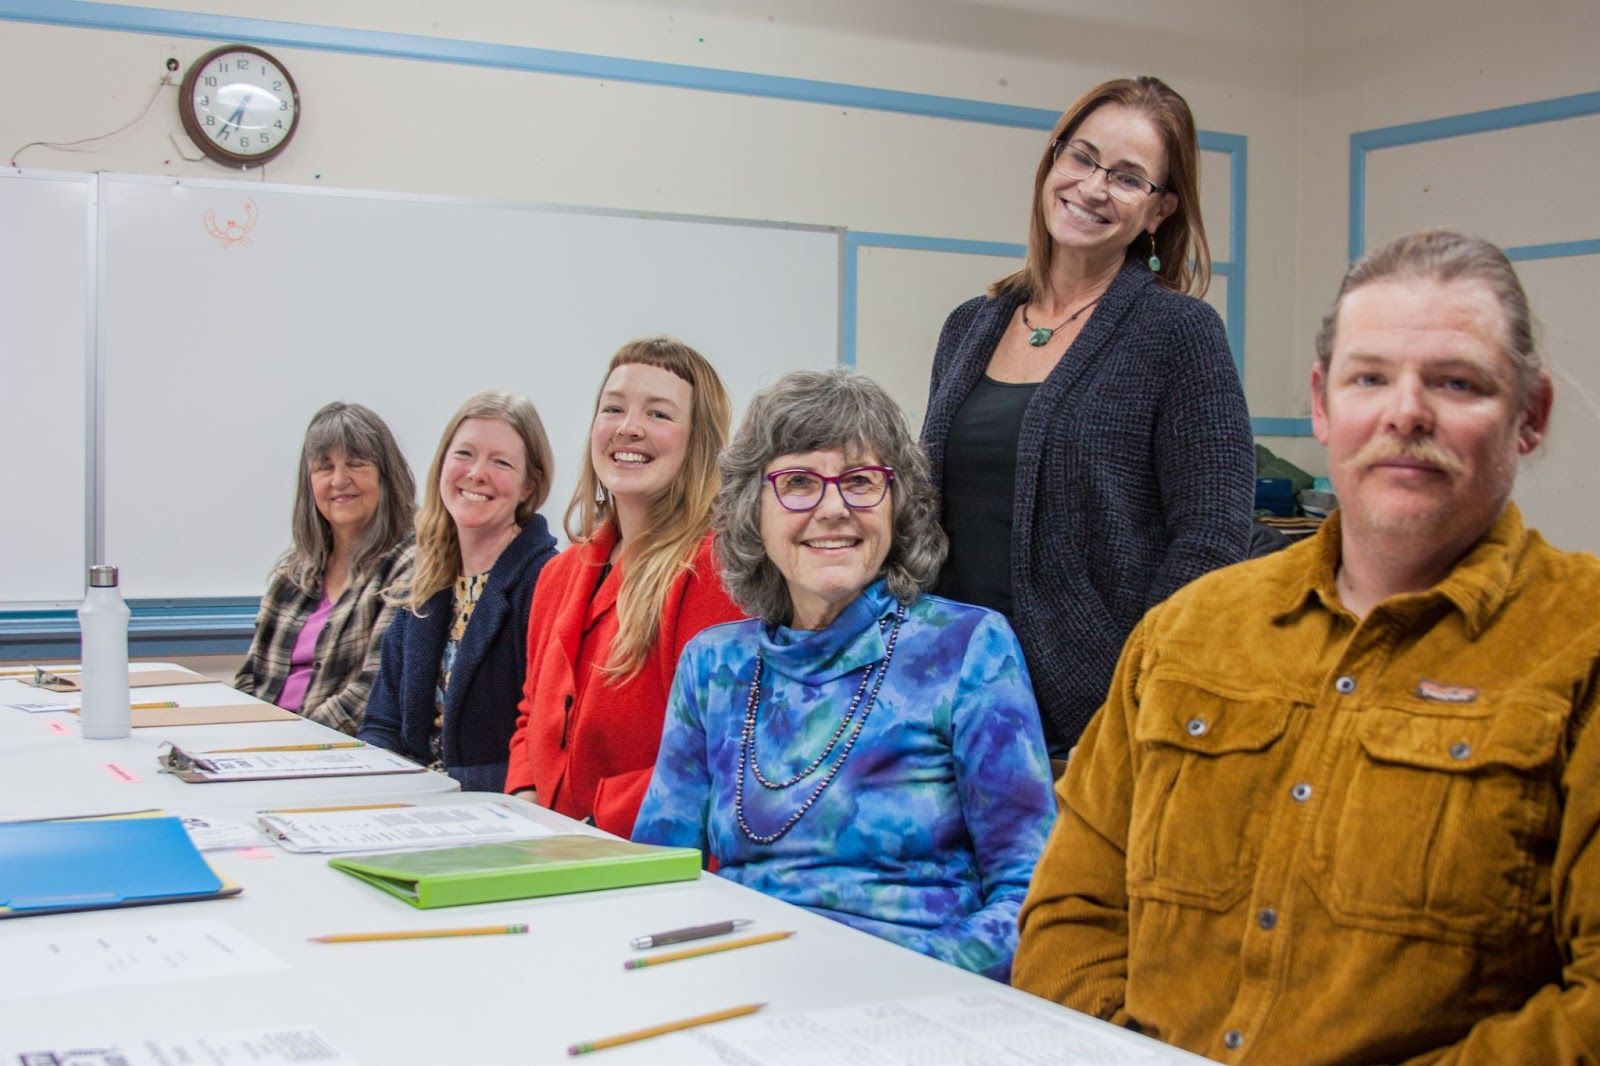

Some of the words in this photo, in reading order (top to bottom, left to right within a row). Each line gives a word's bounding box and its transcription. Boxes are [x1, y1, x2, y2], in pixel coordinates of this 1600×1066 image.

[219, 63, 228, 73] 11
[237, 59, 249, 70] 12
[261, 66, 265, 75] 1
[204, 76, 217, 87] 10
[272, 81, 282, 91] 2
[279, 101, 288, 111] 3
[206, 115, 215, 126] 8
[273, 119, 282, 129] 4
[222, 131, 230, 141] 7
[260, 133, 269, 143] 5
[240, 137, 249, 147] 6
